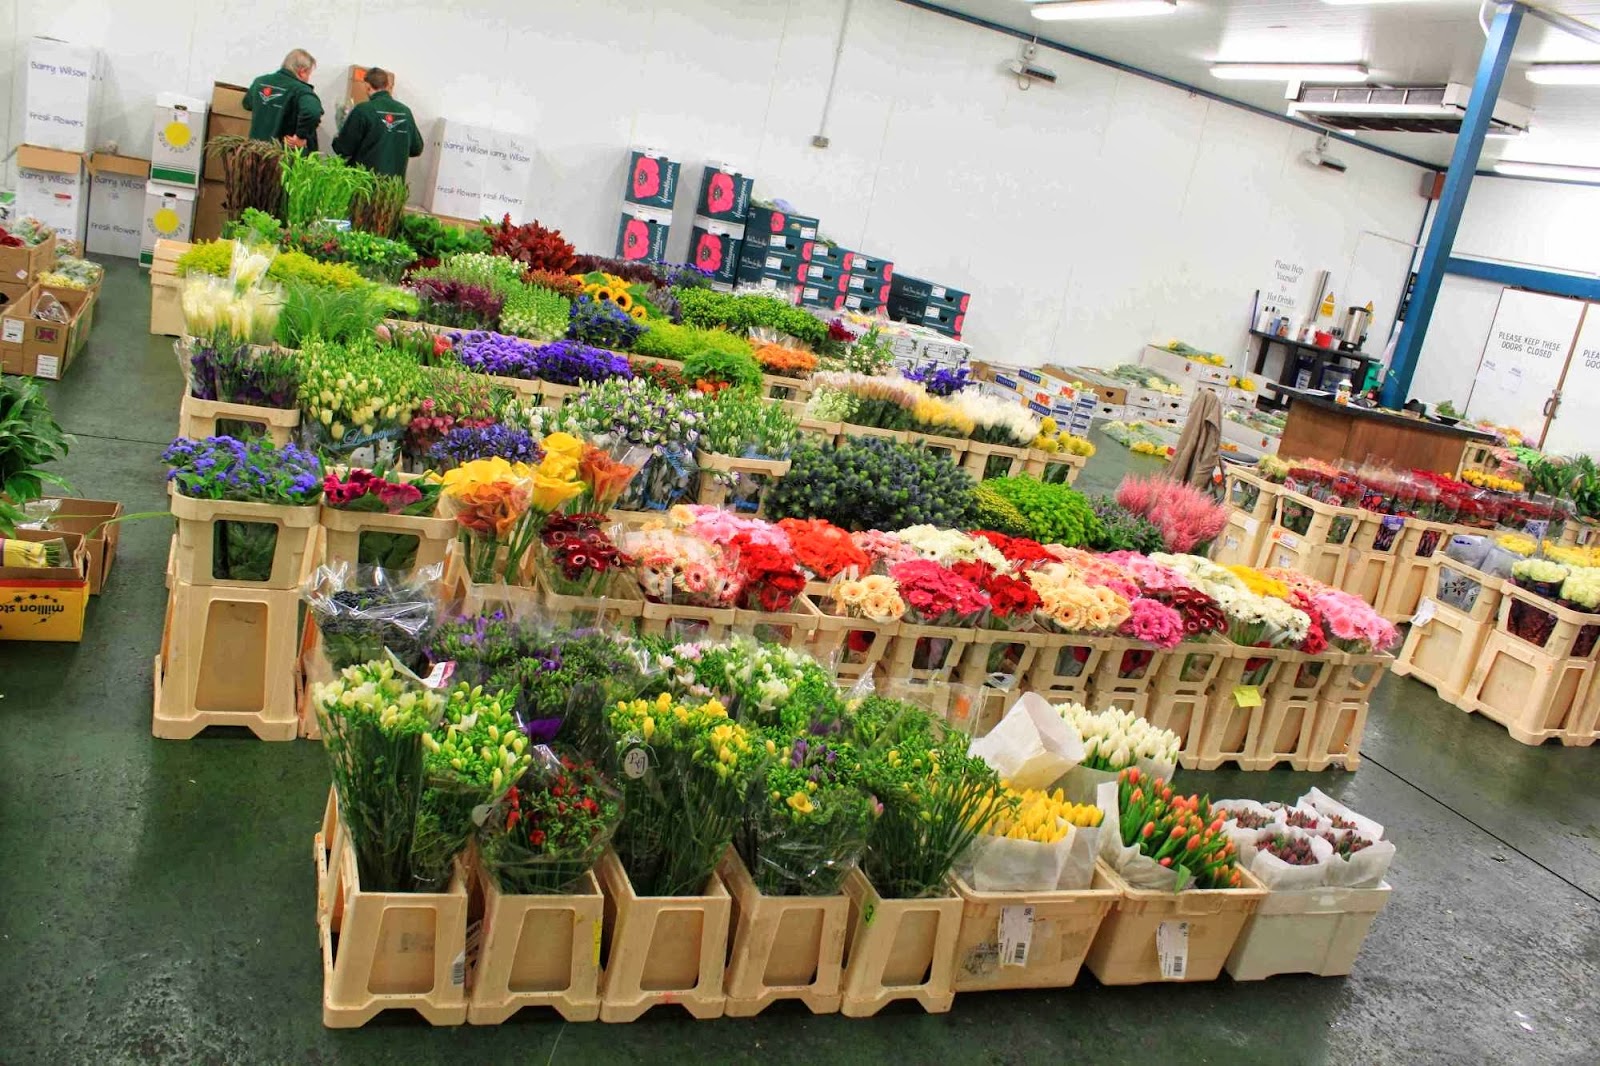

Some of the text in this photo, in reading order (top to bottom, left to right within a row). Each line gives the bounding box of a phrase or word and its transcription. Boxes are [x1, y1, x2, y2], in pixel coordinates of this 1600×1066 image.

[1498, 331, 1561, 353] PLEASE KEEP THESE
[1501, 340, 1552, 359] DOORS CLOSED
[20, 604, 64, 615] million
